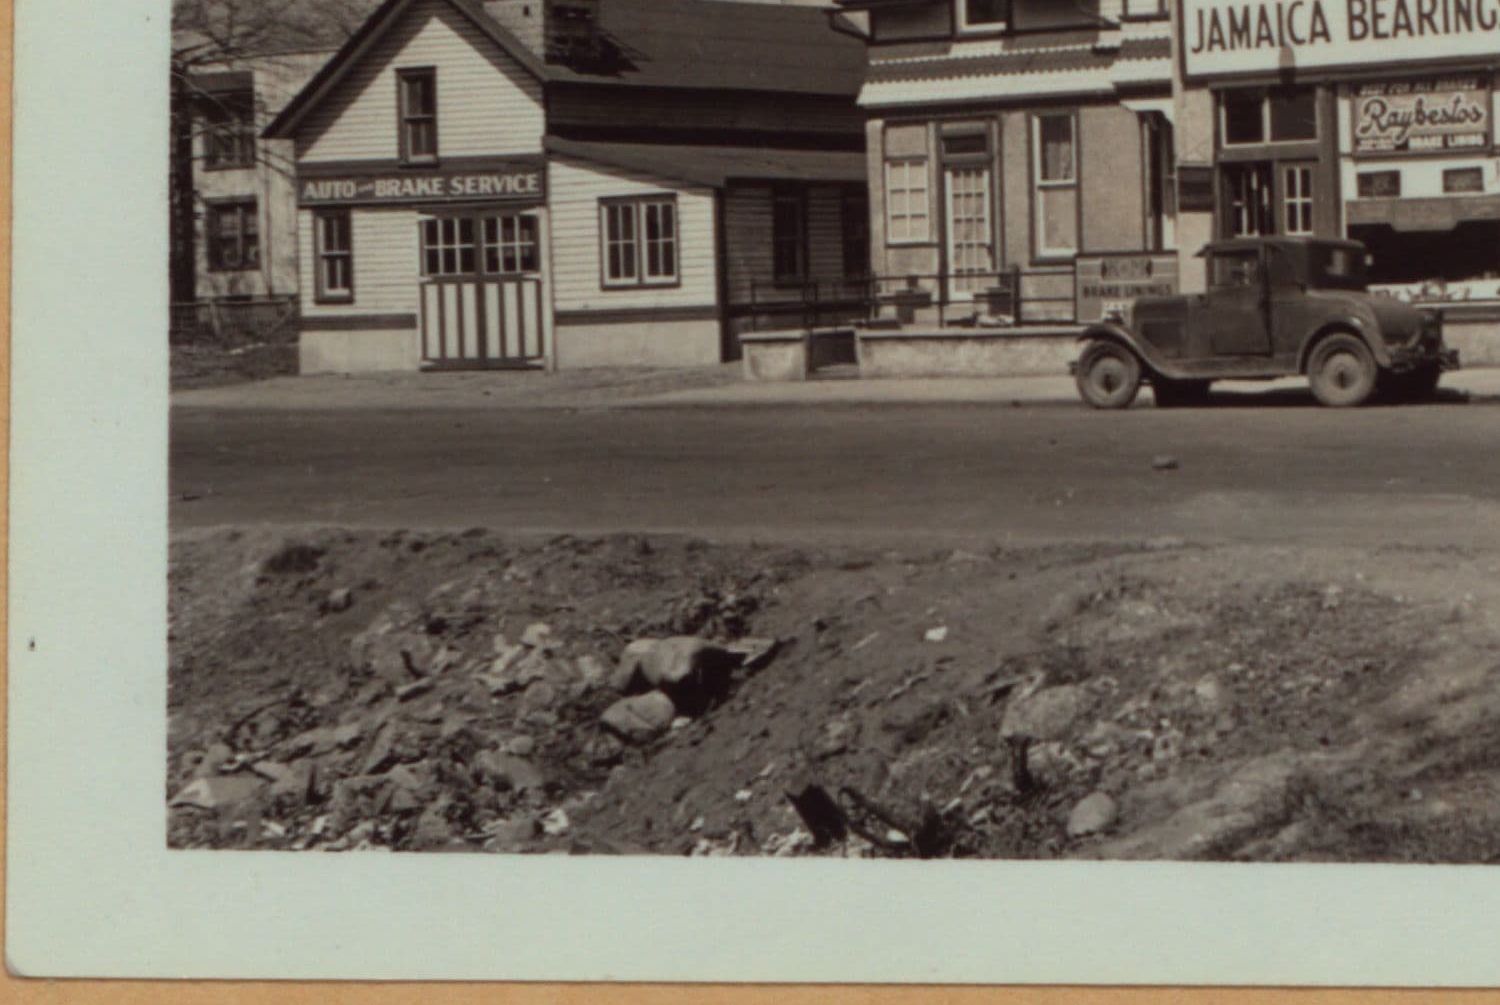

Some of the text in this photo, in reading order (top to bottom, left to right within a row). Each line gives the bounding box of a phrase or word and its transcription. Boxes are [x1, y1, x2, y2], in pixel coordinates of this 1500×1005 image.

[1359, 96, 1484, 142] Raybestos
[302, 180, 355, 200] AUTO
[374, 177, 444, 197] BRAKE
[450, 173, 539, 196] SERVICE
